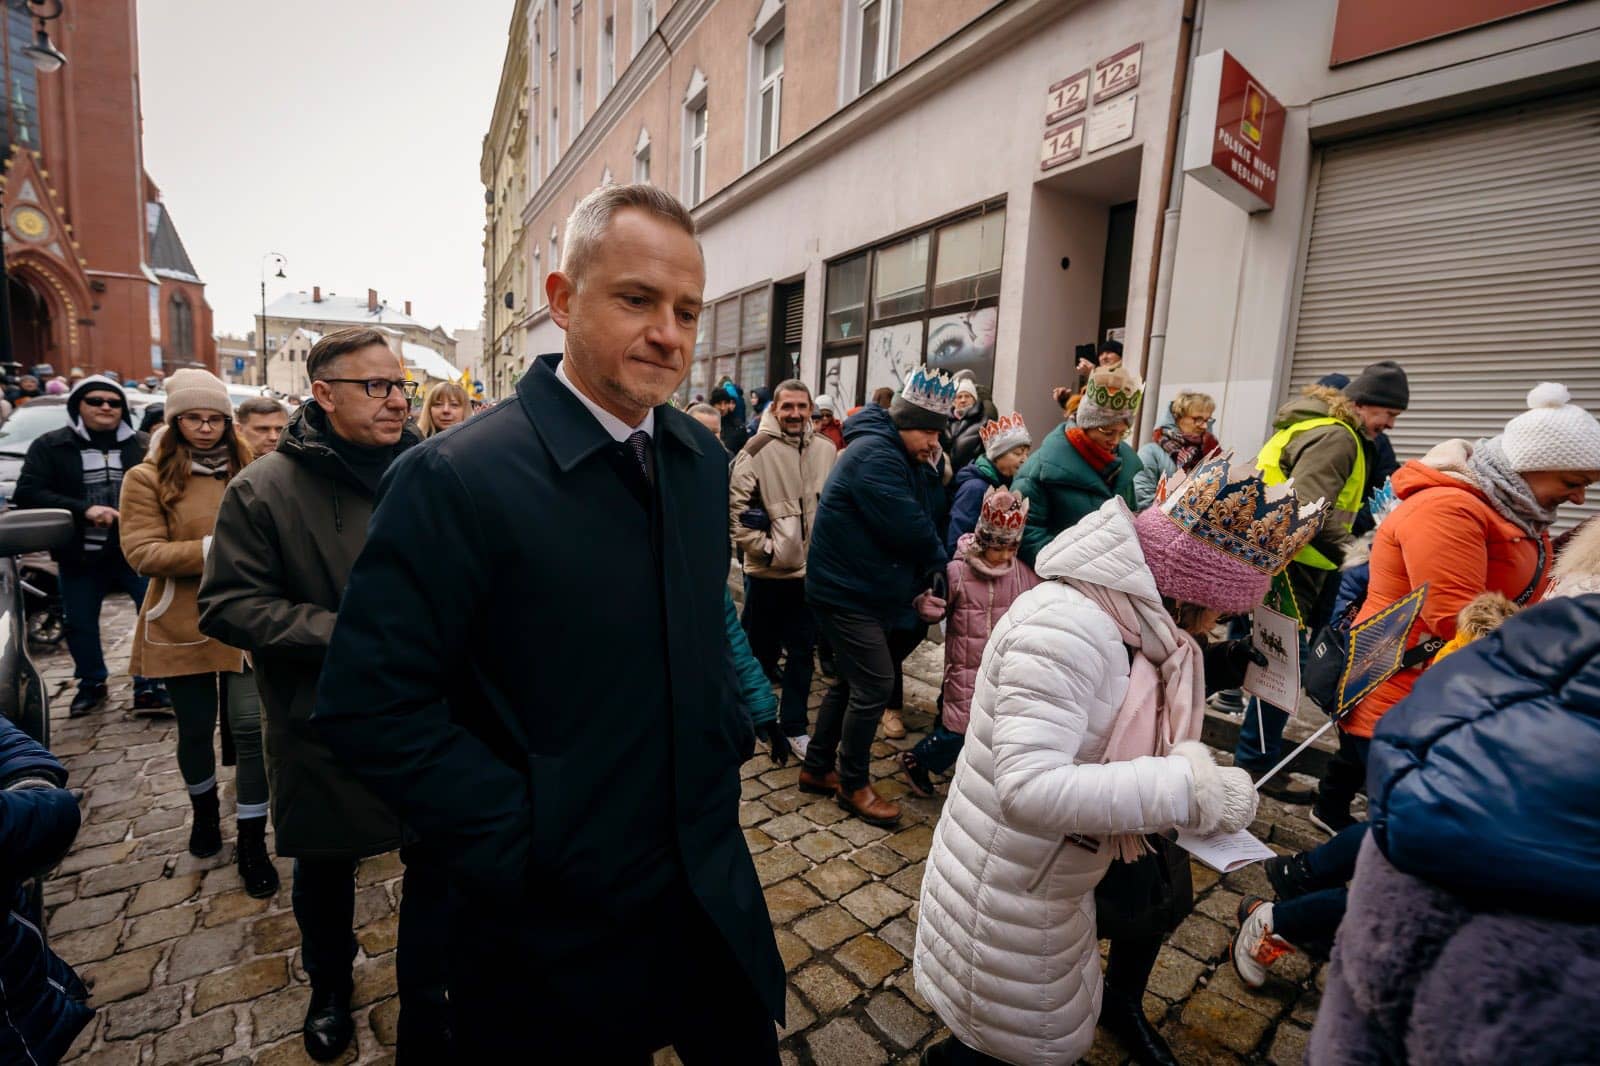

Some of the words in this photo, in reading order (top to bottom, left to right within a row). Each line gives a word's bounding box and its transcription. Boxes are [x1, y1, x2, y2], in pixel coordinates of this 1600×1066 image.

[1097, 62, 1136, 88] 12a
[1054, 83, 1080, 108] 12
[1049, 131, 1074, 154] 14
[1218, 127, 1251, 163] POLSKIE
